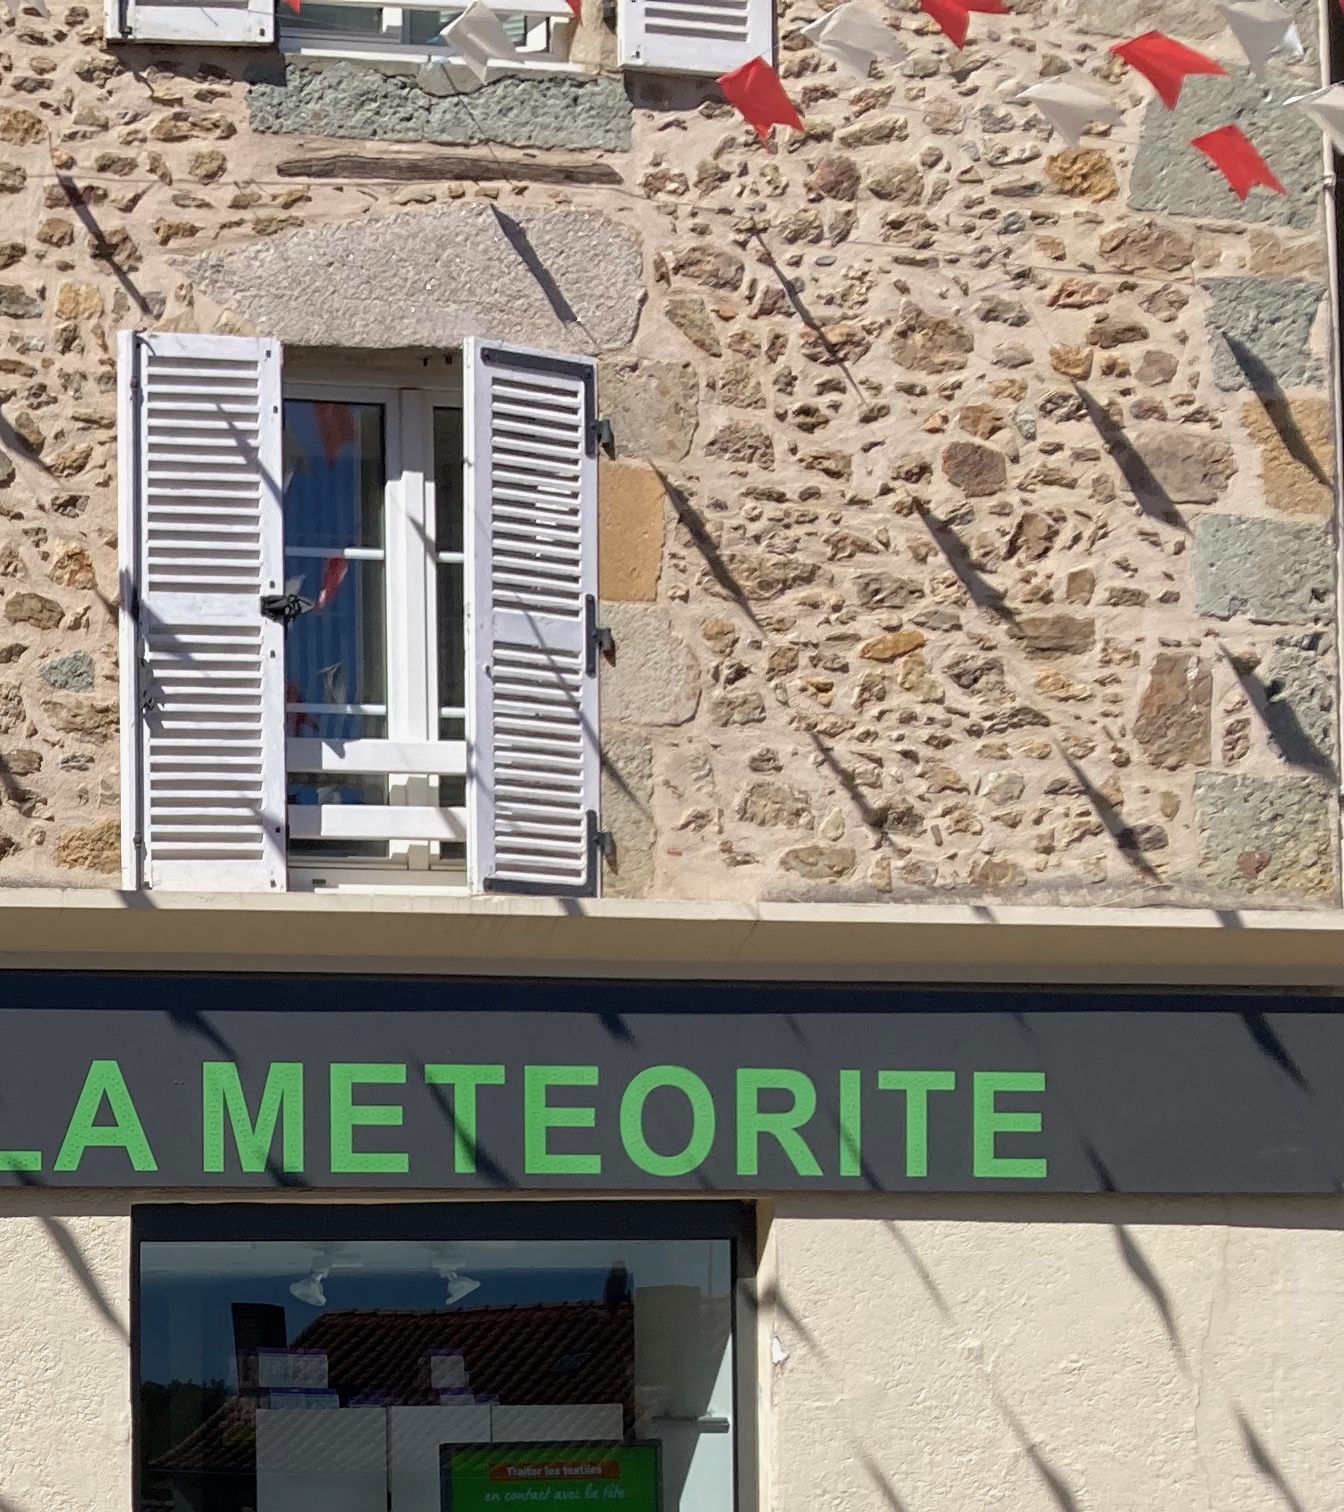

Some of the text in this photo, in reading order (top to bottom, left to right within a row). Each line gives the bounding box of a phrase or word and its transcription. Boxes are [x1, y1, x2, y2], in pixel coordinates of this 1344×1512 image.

[202, 1062, 1048, 1177] METEORITE
[506, 1464, 603, 1477] Traiter les textiles
[484, 1482, 625, 1501] en contact avec la tête
